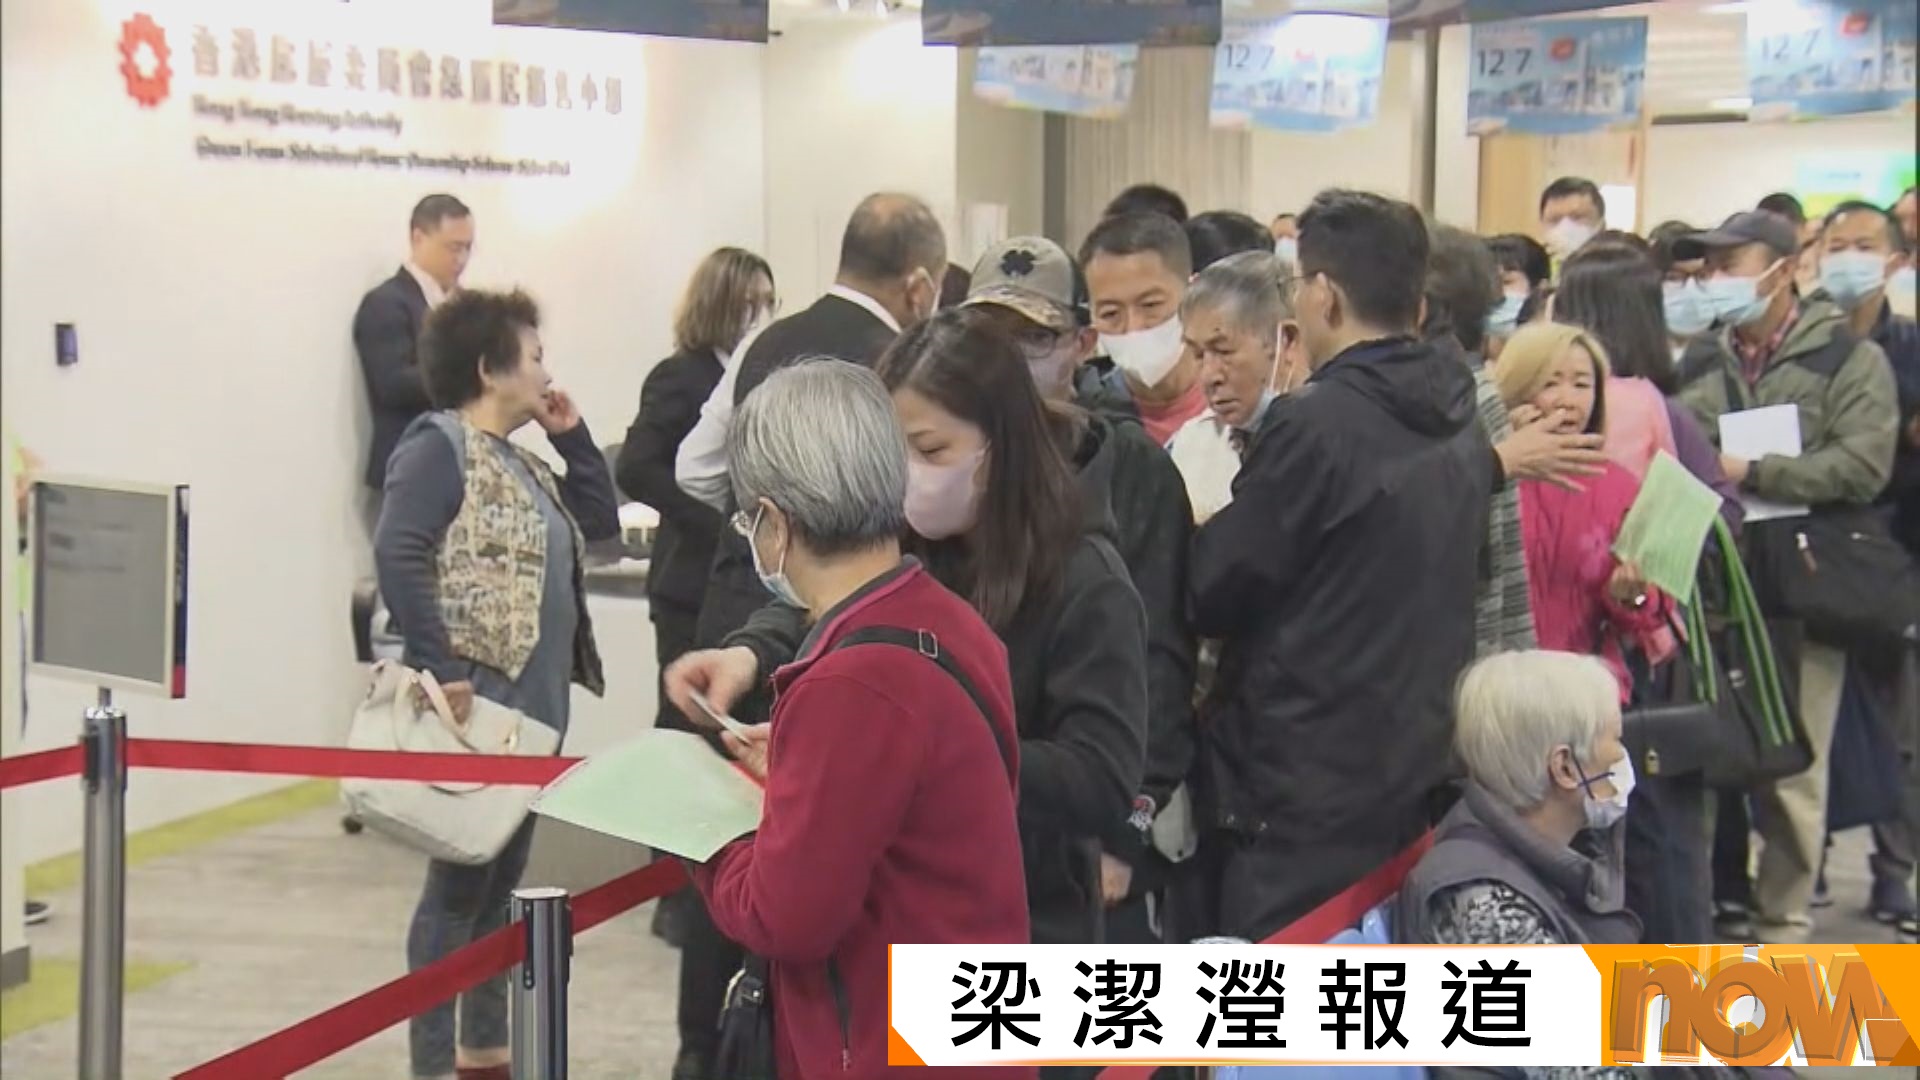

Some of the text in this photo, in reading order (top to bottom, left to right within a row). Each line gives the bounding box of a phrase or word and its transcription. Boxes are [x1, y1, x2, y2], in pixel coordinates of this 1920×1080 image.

[1225, 43, 1250, 68] 12
[1478, 49, 1504, 76] 12
[1516, 48, 1532, 75] 7
